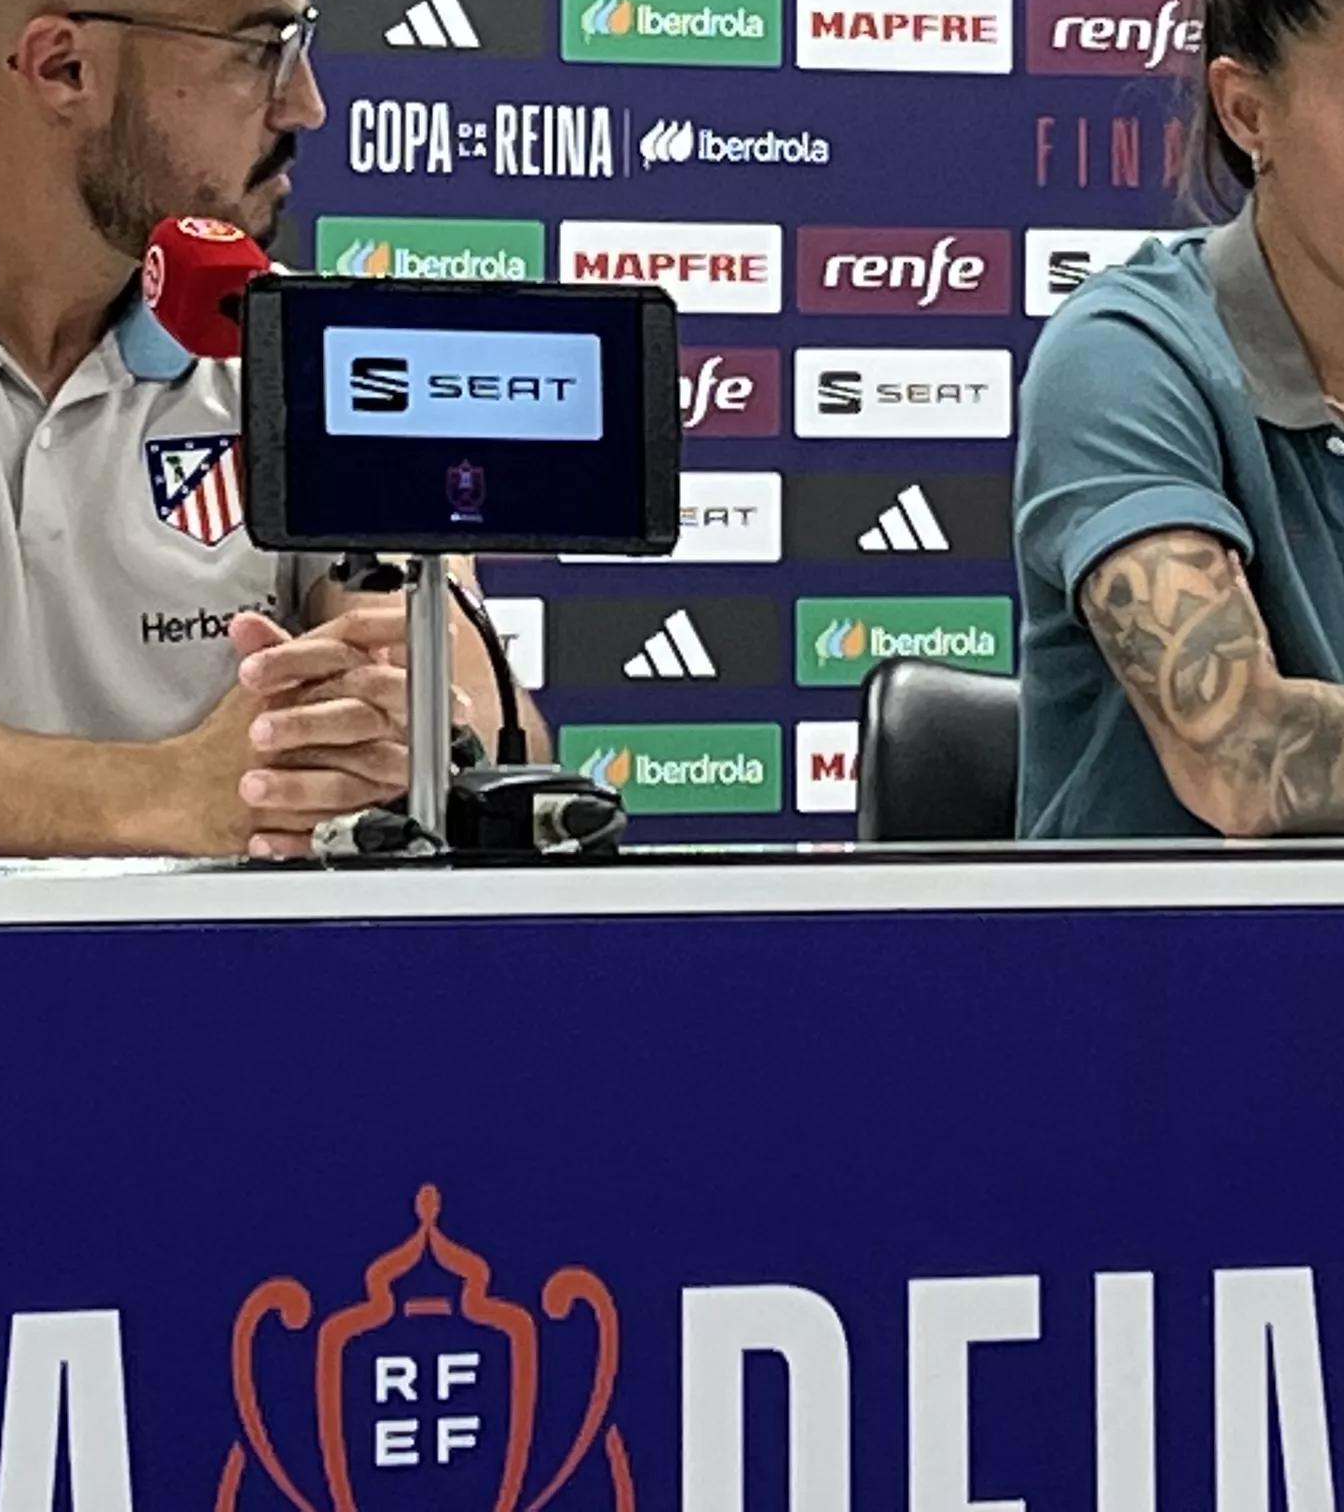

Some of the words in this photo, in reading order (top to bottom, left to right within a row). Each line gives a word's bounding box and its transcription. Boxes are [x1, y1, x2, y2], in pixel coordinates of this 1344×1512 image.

[638, 5, 763, 37] Iberdrola
[812, 12, 993, 42] MAPFRE
[351, 100, 451, 172] COPA
[496, 105, 613, 177] REINA
[699, 130, 828, 162] Iberdrola
[1036, 116, 1186, 187] FINA
[394, 248, 527, 279] Iberdrola
[573, 253, 767, 283] MAPFRE
[825, 237, 983, 305] renfe
[429, 376, 575, 400] SEAT
[877, 384, 987, 403] SEAT
[680, 506, 757, 526] EAT
[871, 627, 994, 657] Iberdrola
[637, 754, 763, 784] Iberdrola
